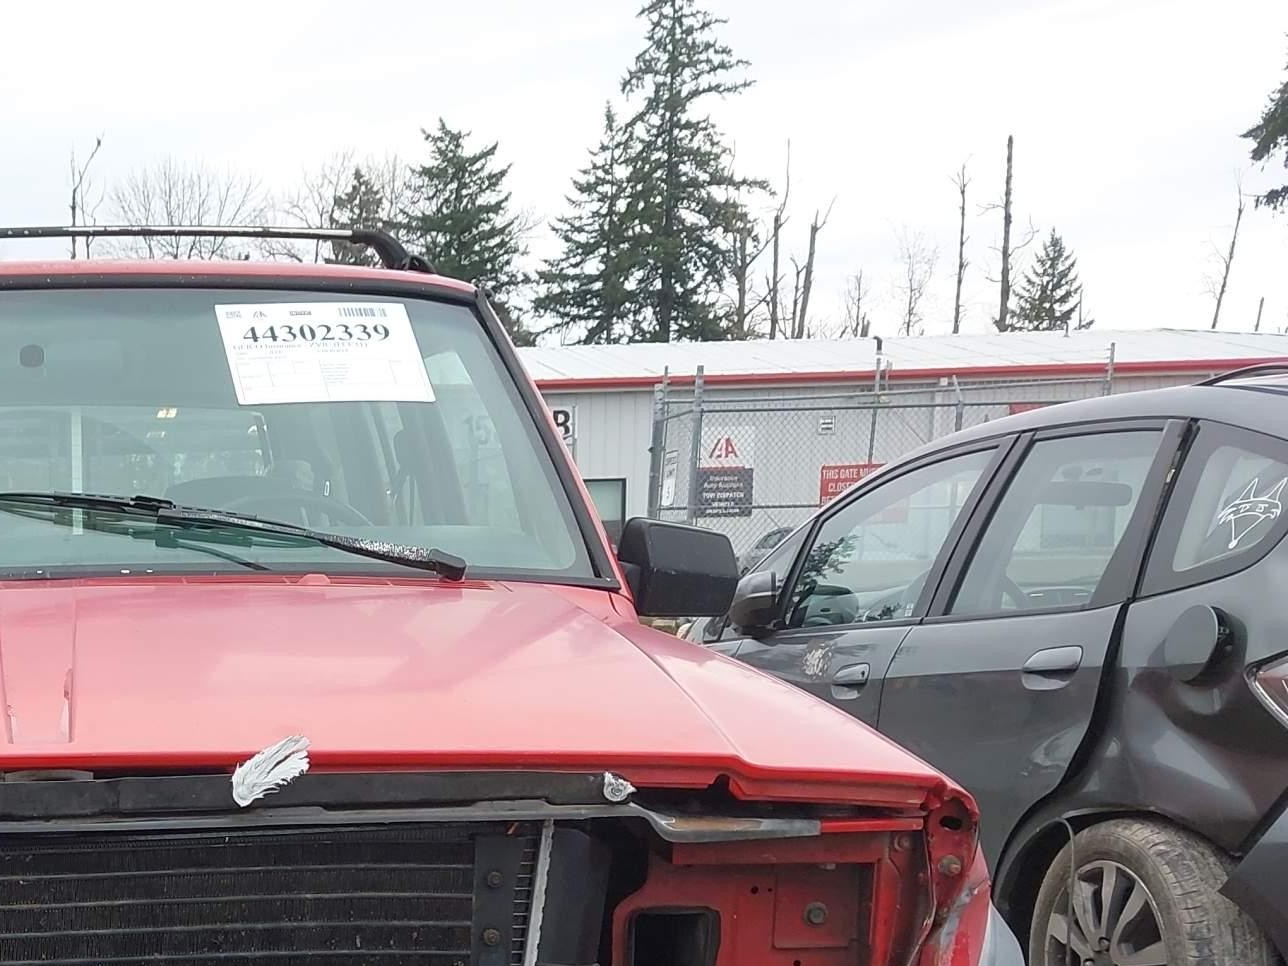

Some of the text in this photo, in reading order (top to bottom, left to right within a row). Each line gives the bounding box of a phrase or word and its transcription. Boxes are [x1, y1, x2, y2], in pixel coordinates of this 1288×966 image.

[243, 323, 390, 343] 44302339
[822, 468, 839, 480] THIS
[839, 467, 858, 479] GATE
[827, 481, 855, 493] CLOSE
